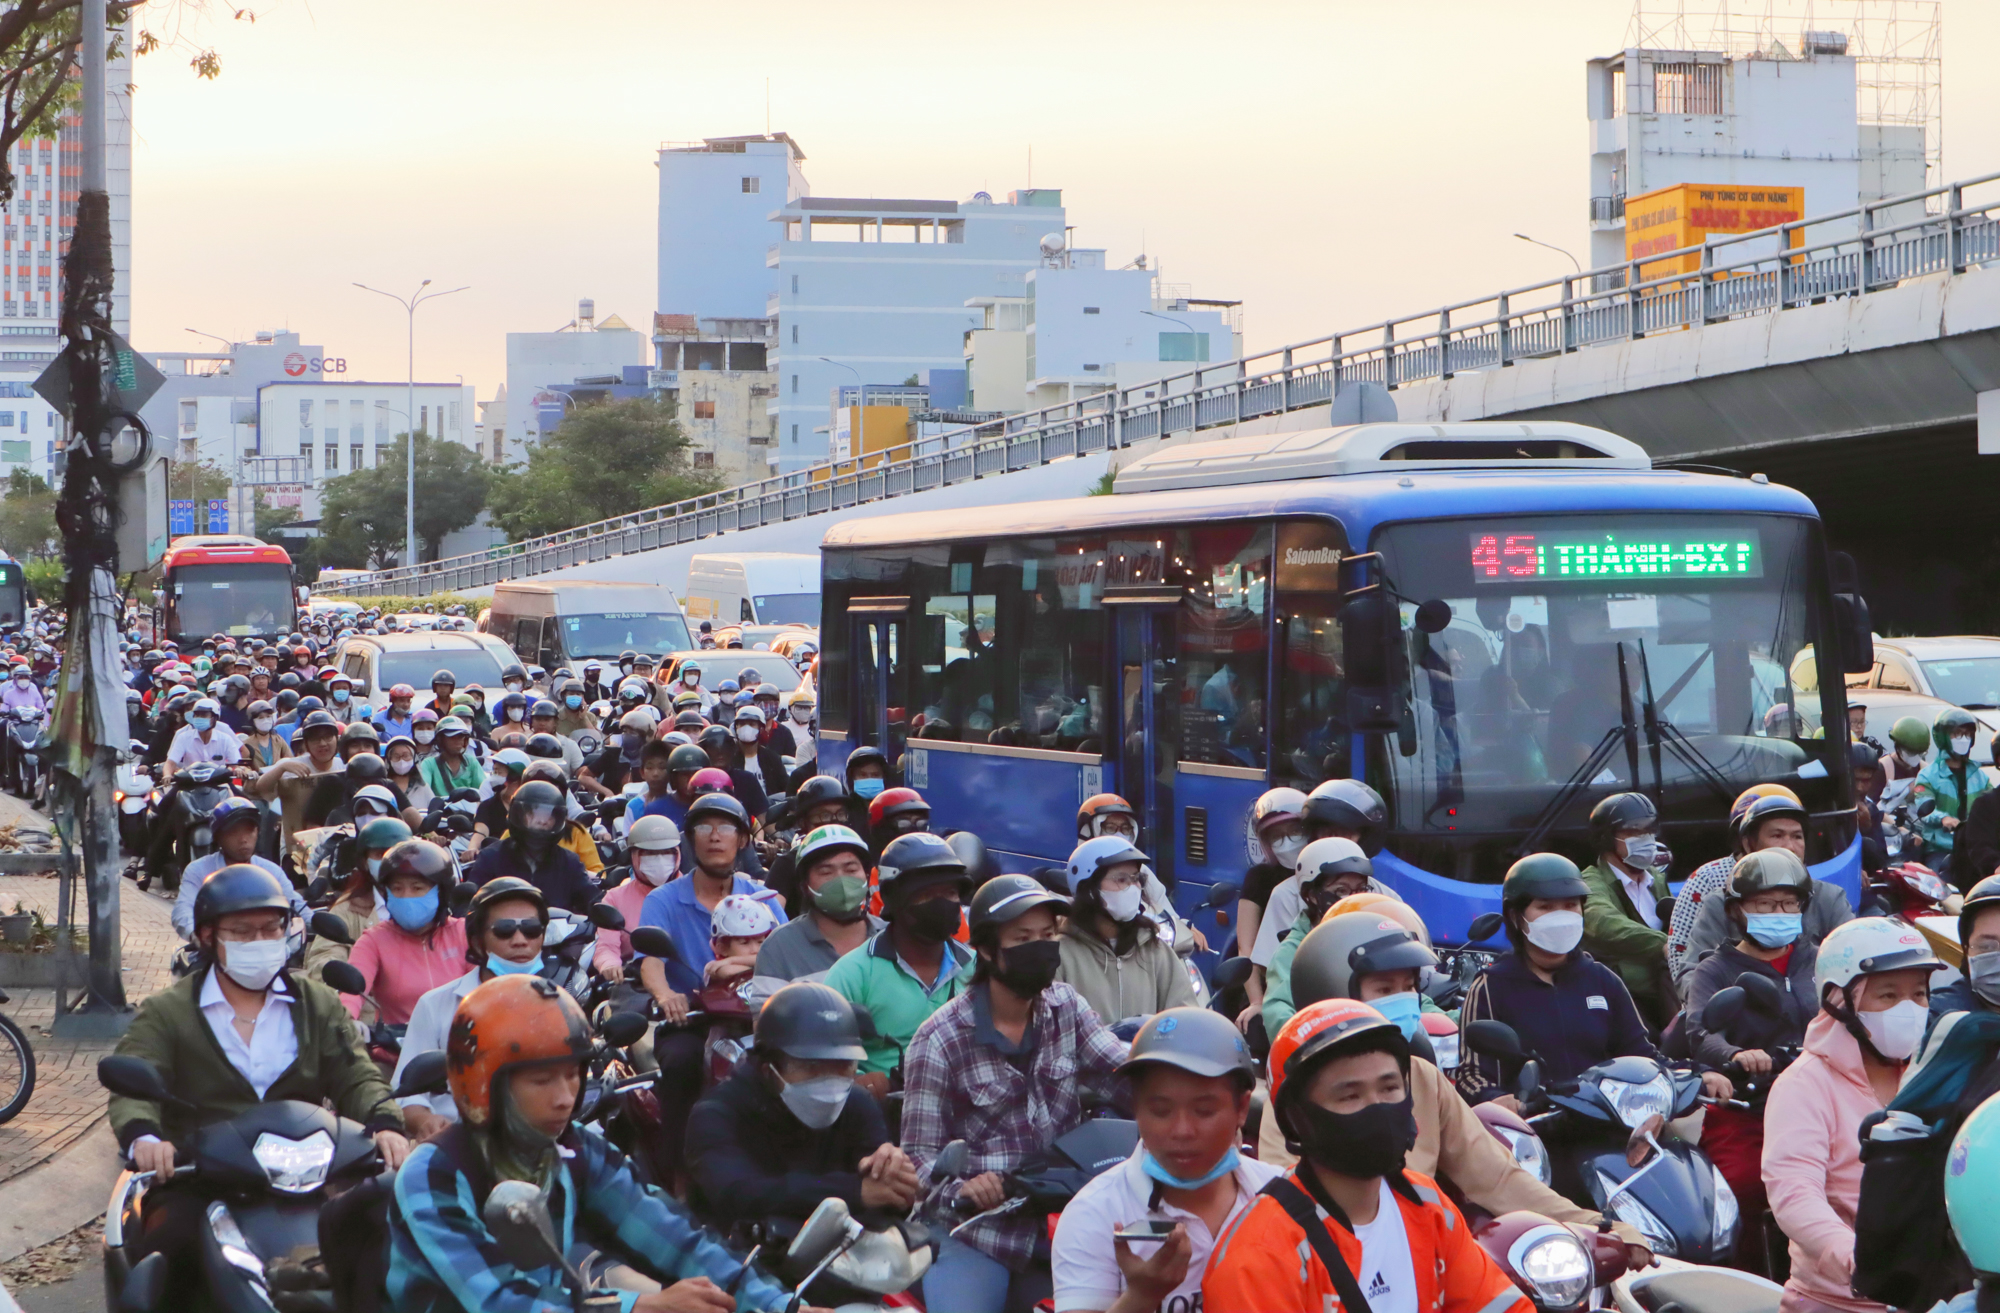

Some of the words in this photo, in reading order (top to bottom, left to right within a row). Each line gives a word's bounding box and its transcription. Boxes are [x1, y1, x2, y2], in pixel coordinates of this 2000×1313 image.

[310, 357, 347, 373] SCB
[1285, 547, 1341, 566] SaigonBus
[1472, 535, 1538, 575] 45
[1310, 1007, 1369, 1027] ShopeeFood
[1093, 1156, 1127, 1168] HONDA
